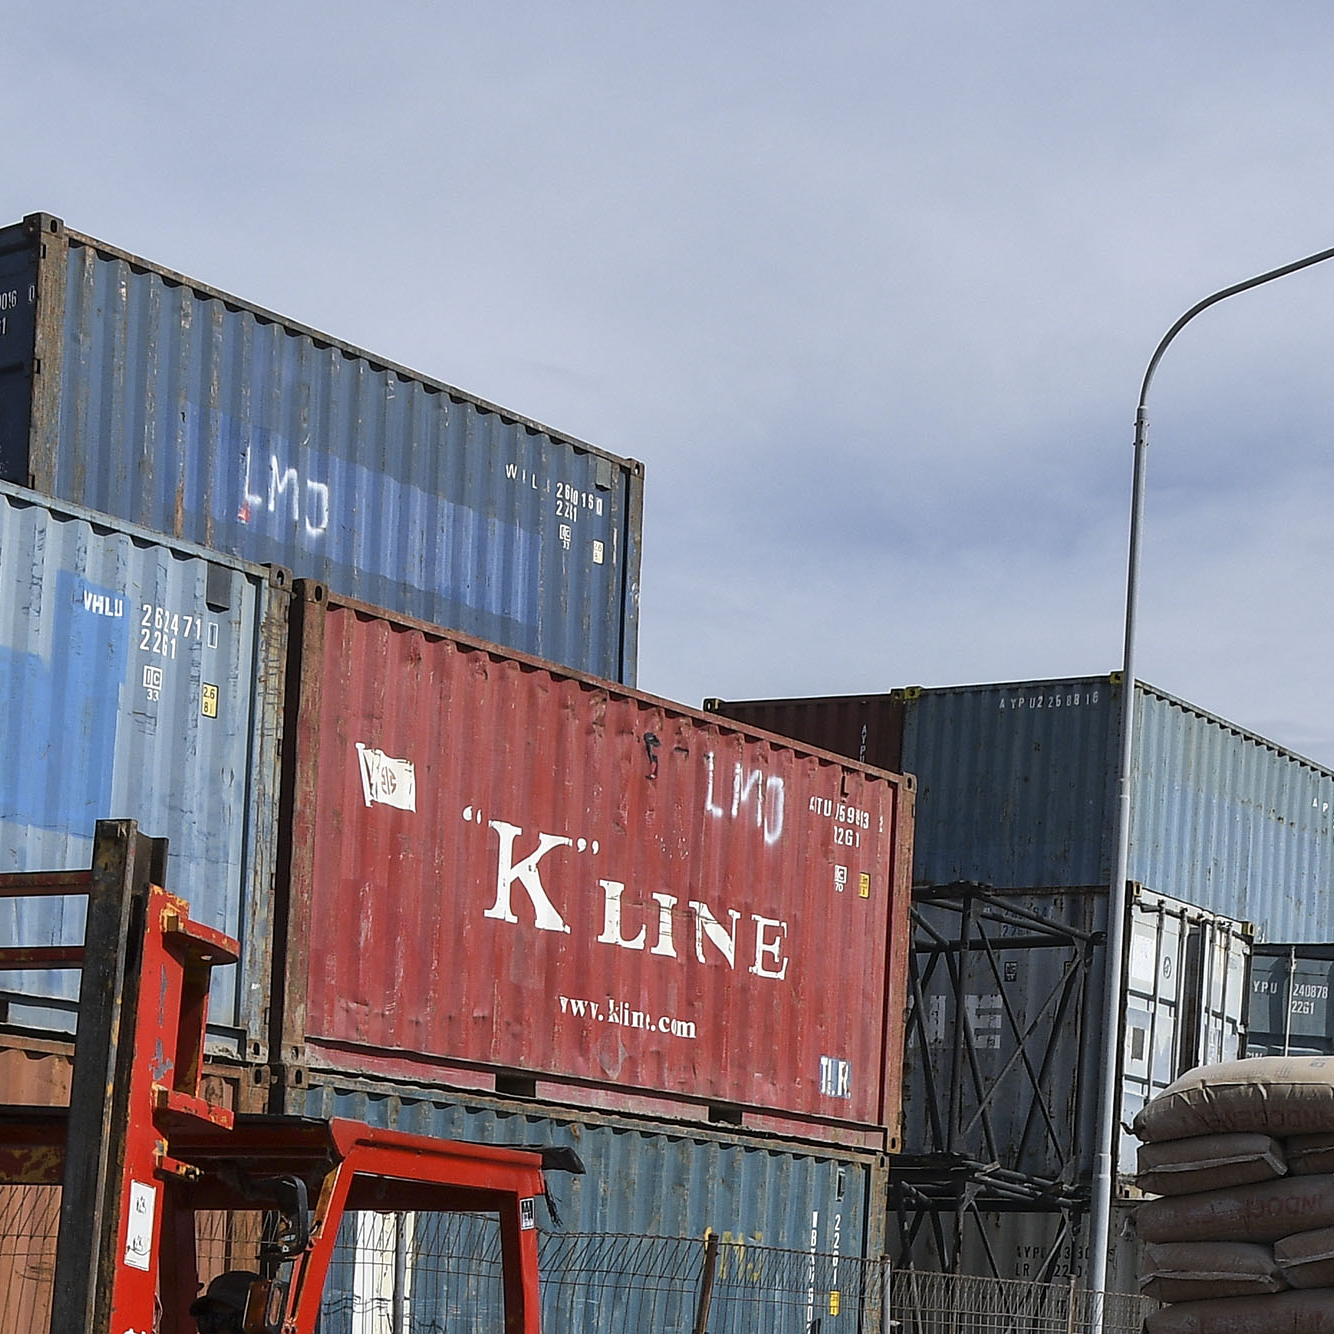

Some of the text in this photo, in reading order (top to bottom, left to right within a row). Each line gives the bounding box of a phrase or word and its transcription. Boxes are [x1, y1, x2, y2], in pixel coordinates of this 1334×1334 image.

[141, 604, 202, 641] 262471
[597, 879, 789, 981] LINE
[1292, 983, 1329, 999] 240878
[1291, 1000, 1315, 1015] 22G1
